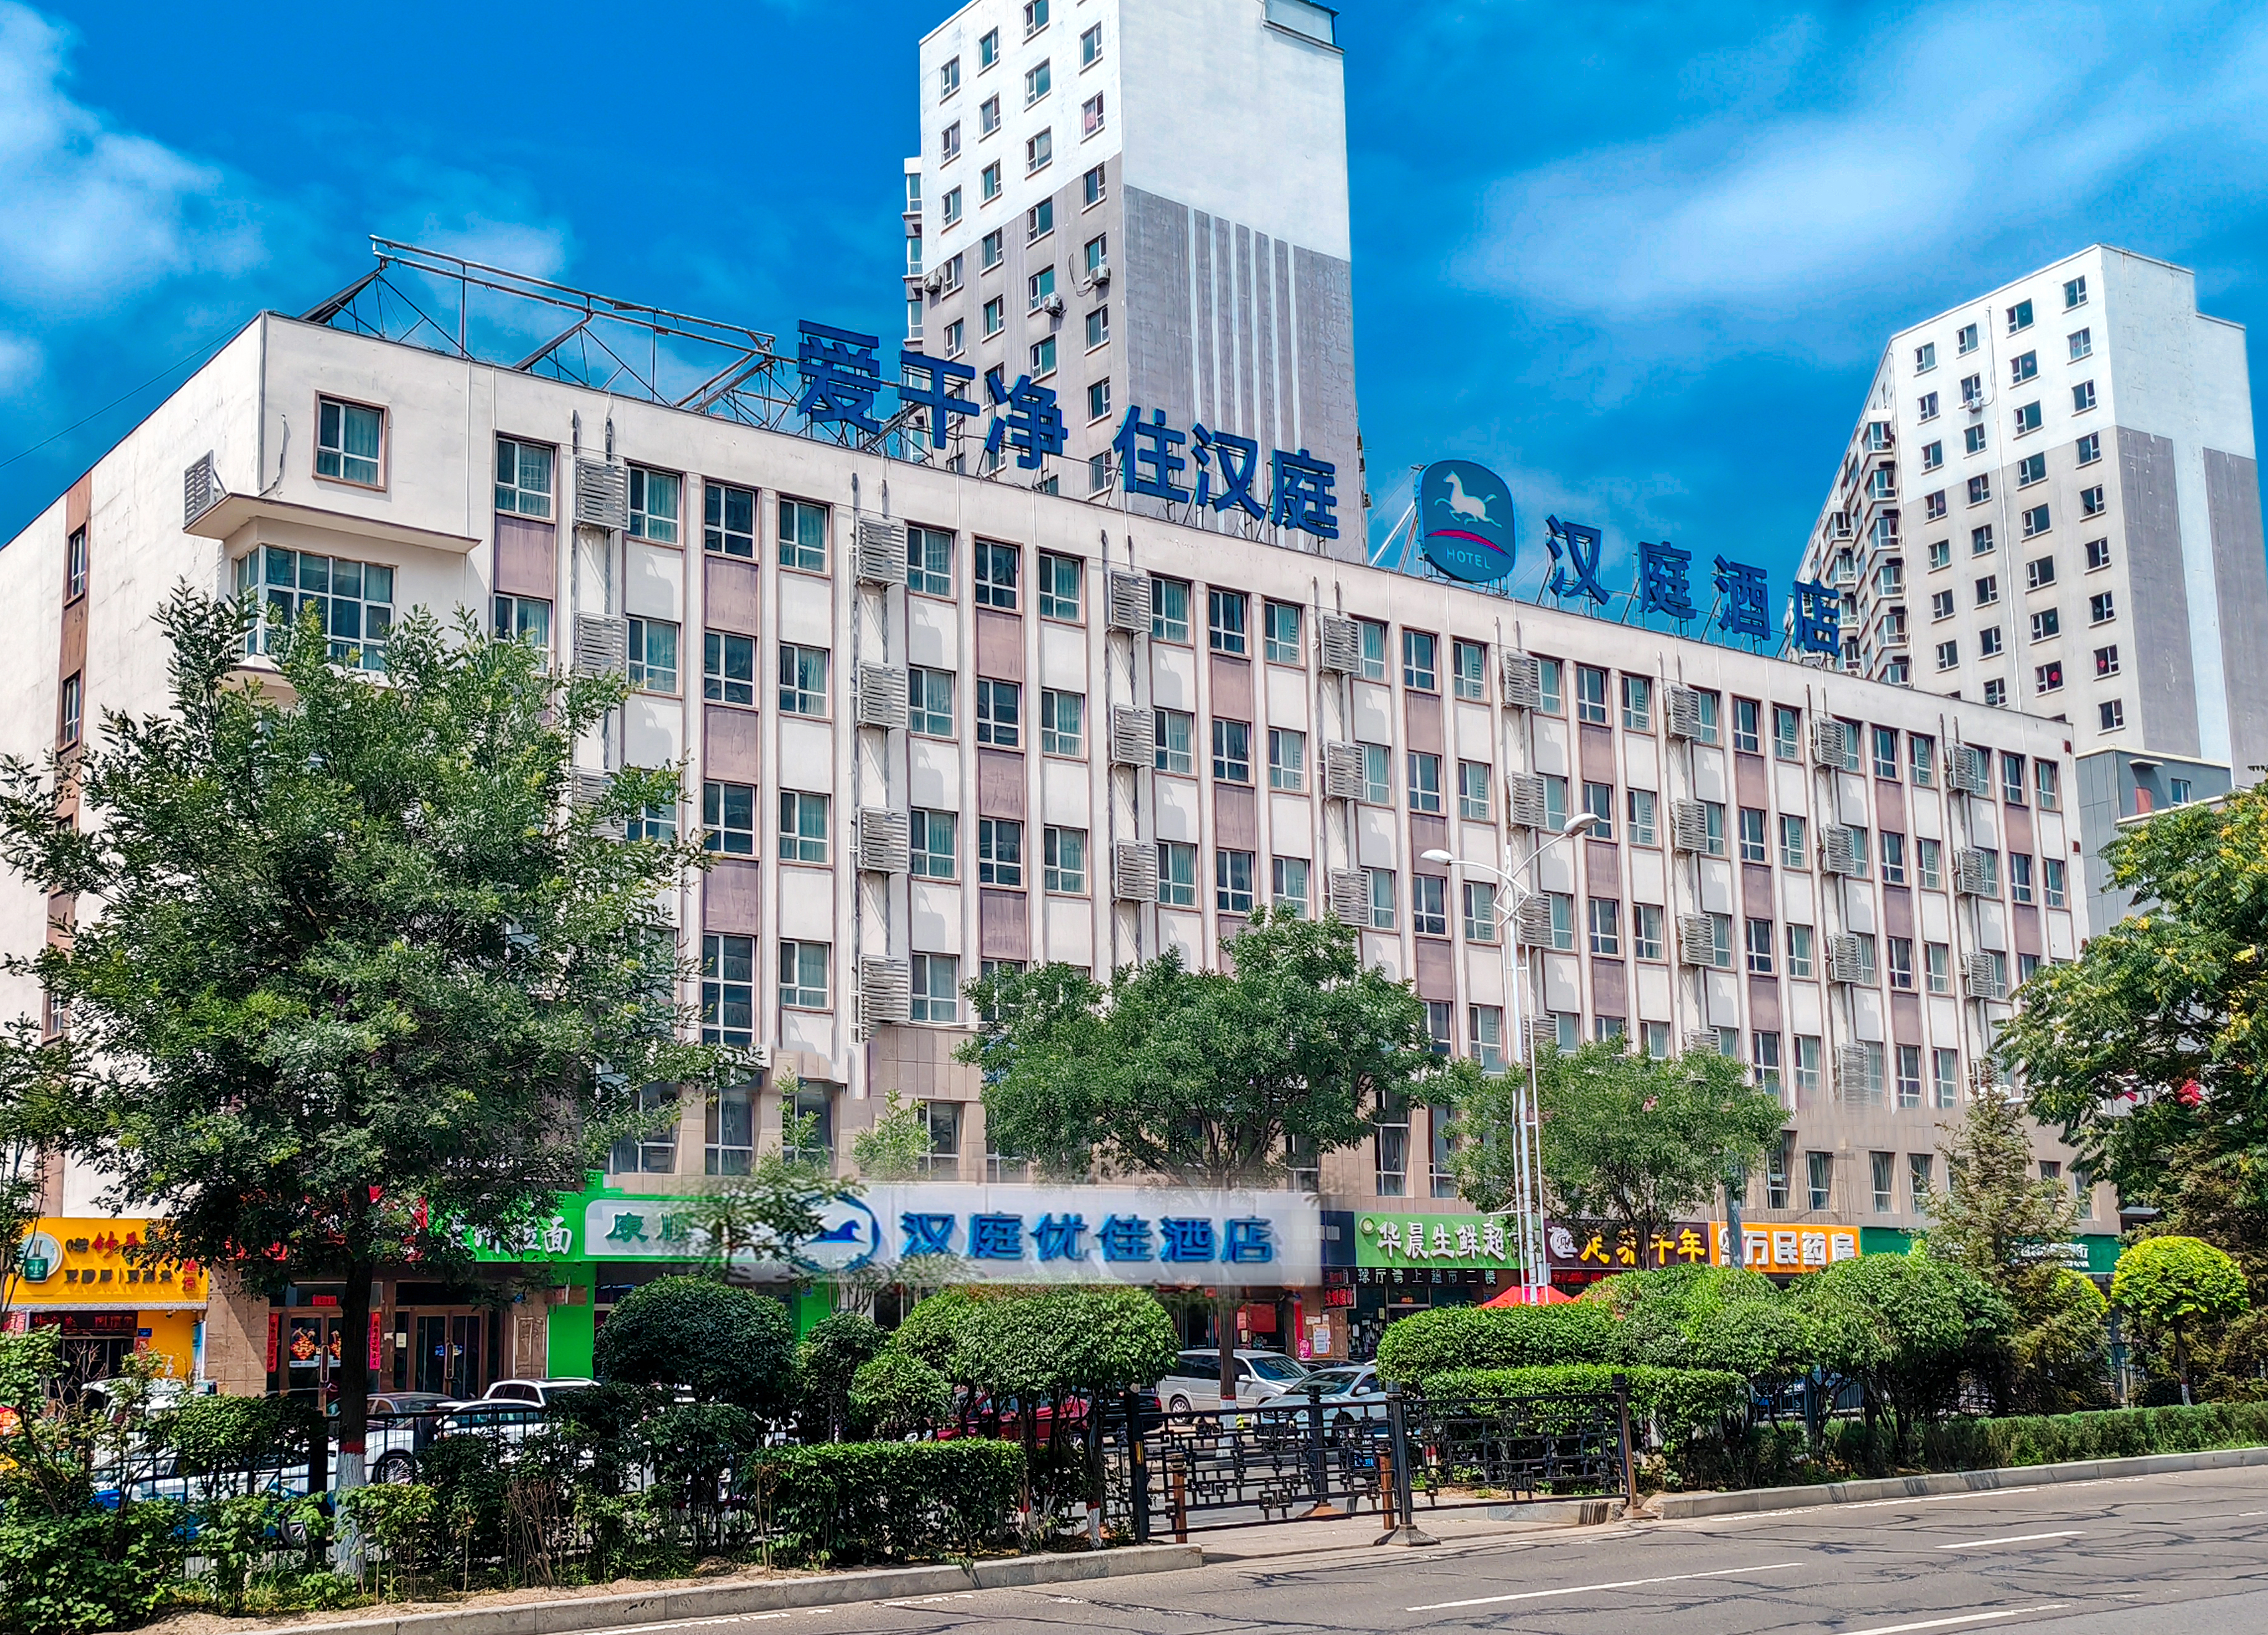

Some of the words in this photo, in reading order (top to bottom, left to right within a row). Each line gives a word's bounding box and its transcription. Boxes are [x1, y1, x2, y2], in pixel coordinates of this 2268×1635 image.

[797, 319, 1068, 470] 爱干净
[1111, 404, 1339, 539] 住汉庭
[1446, 547, 1491, 570] HOTEL
[1545, 514, 1840, 657] 汉庭酒店
[900, 1211, 1274, 1263] 汉庭优佳酒店
[1744, 1230, 1855, 1265] 万民药房
